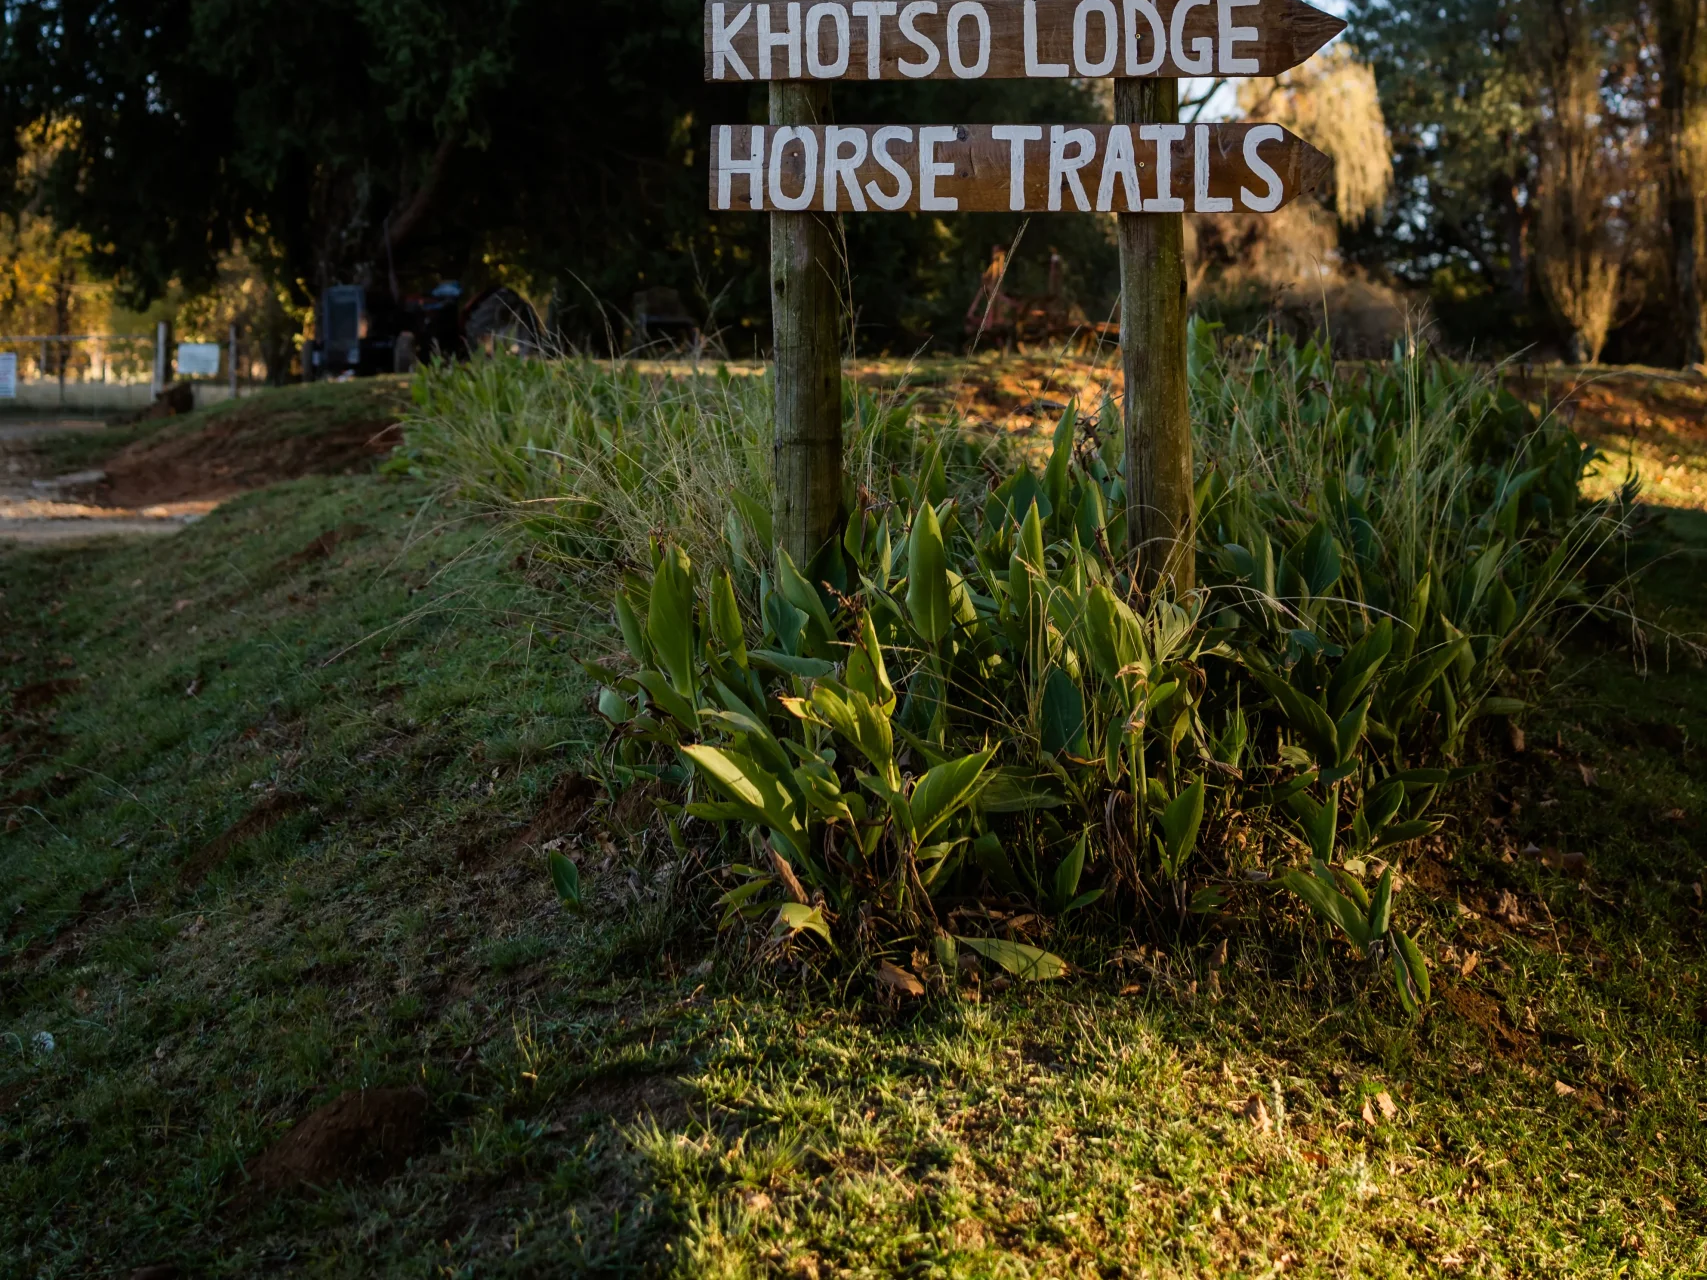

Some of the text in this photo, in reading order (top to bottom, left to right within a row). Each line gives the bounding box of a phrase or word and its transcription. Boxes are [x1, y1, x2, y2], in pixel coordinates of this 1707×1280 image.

[711, 1, 991, 80] KHOTSO
[717, 123, 1285, 213] HORSE TRAILS
